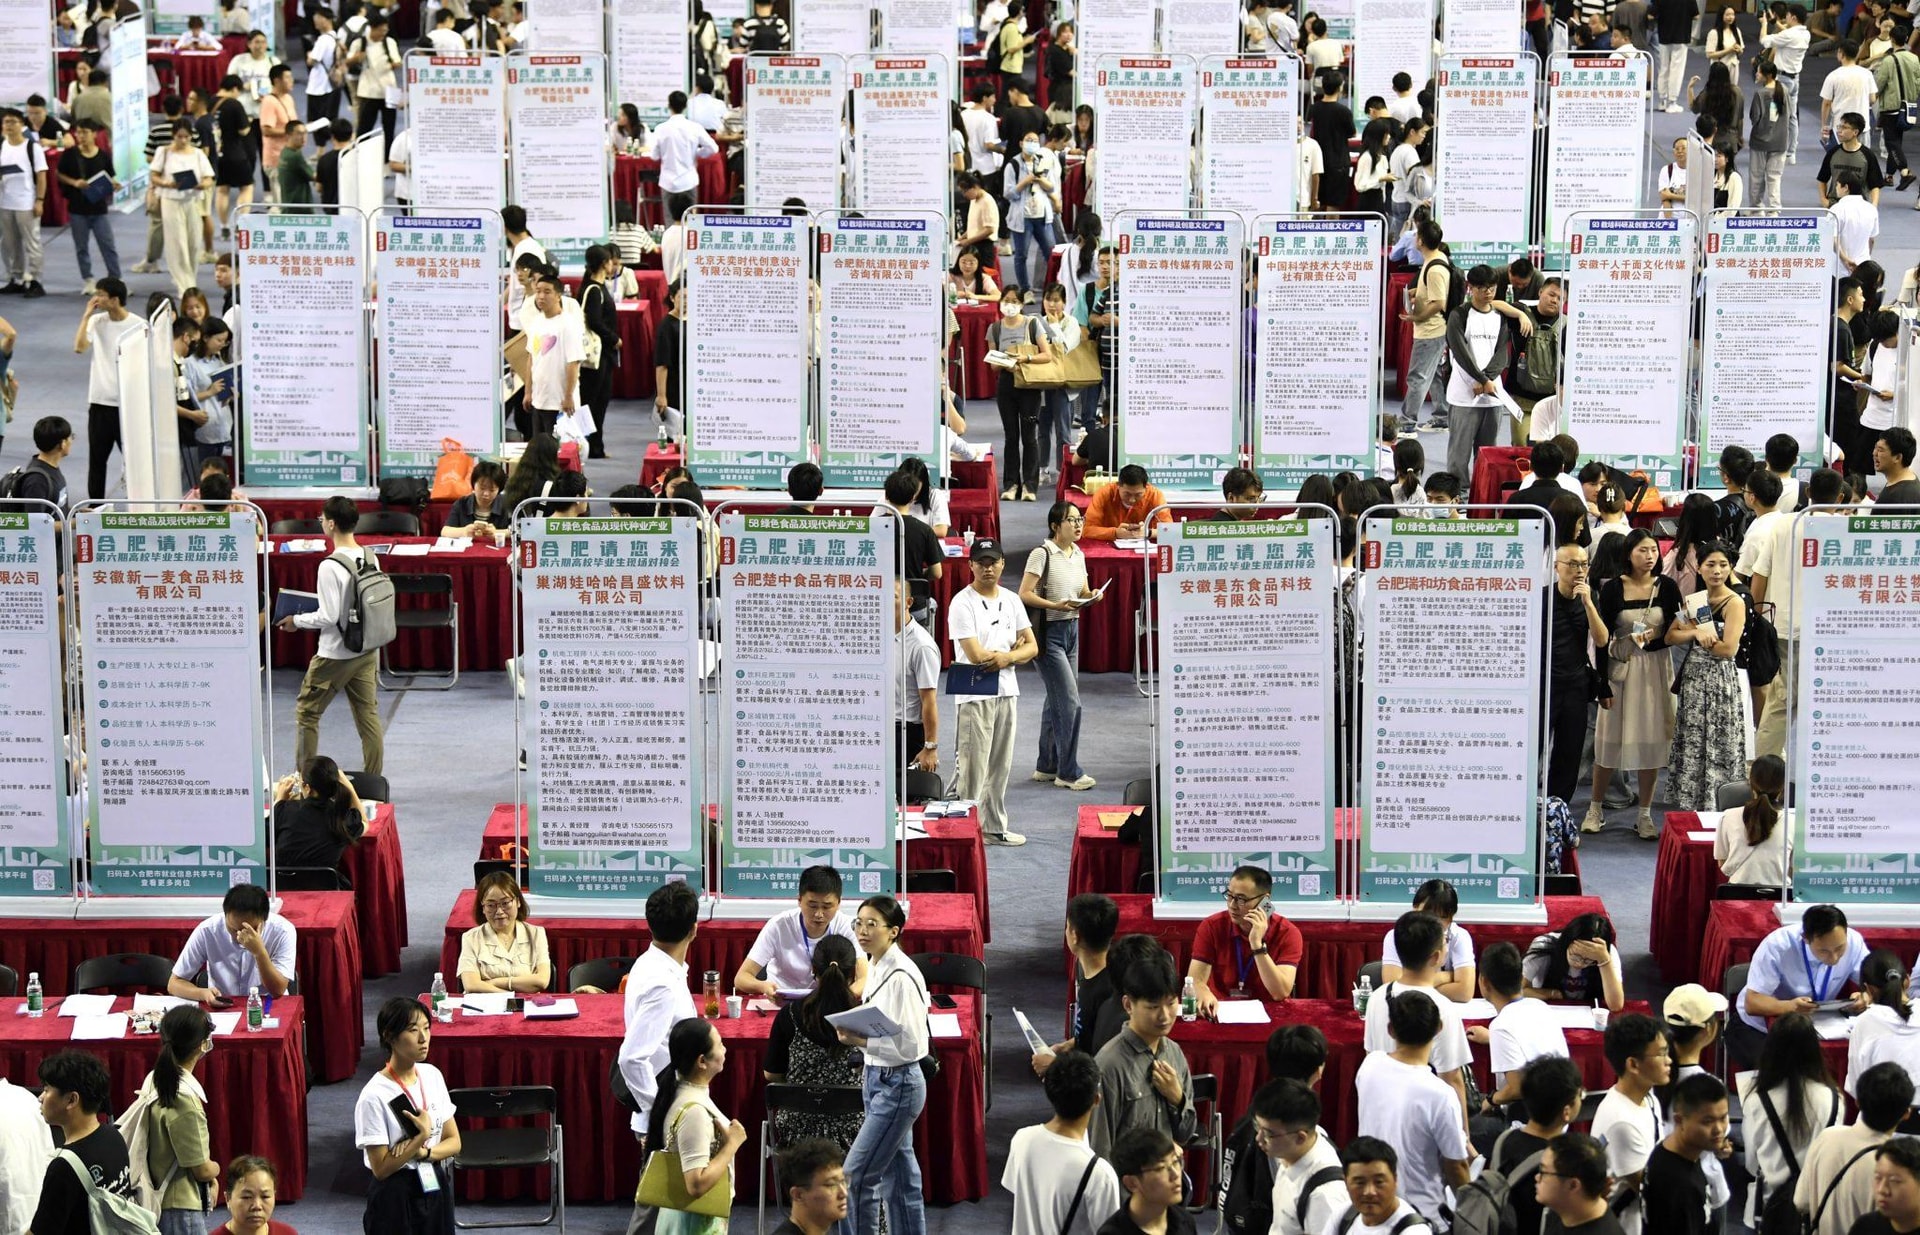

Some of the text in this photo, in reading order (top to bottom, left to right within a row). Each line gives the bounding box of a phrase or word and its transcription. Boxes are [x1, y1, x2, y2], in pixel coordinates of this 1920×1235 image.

[253, 231, 349, 243] 合肥请您来
[390, 232, 485, 245] 合肥请您来
[701, 231, 796, 242] 合肥请您来
[835, 234, 929, 246] 合肥请您来
[1133, 235, 1228, 247] 合肥请您来
[1586, 235, 1680, 246] 合肥请您来
[1723, 233, 1820, 245] 合肥请您来
[1273, 237, 1368, 248] 合肥请您来
[1267, 260, 1373, 271] 中国科学技术大学出版
[1579, 259, 1686, 269] 安徽千人千面文化传媒
[281, 266, 323, 277] 有限公司
[418, 268, 459, 278] 有限公司
[700, 266, 796, 277] 有限公司安徽分公司
[850, 269, 914, 280] 咨询有限公司
[1283, 271, 1357, 282] 社有限责任公司
[1610, 270, 1652, 280] 有限公司
[1748, 269, 1791, 279] 有限公司
[106, 517, 117, 525] 56
[550, 521, 668, 531] 57 绿色食品及现代种业产业
[1854, 520, 1866, 528] 61
[1396, 523, 1406, 531] 60
[98, 535, 236, 552] 合肥请您来
[541, 541, 678, 557] 合肥请您来
[740, 538, 875, 556] 合肥请您来
[1178, 542, 1314, 561] 合肥请您来
[1386, 542, 1524, 558] 合肥请您来
[96, 552, 239, 562] 第六期高校毕业生现场对接会
[540, 558, 680, 567] 第六期高校毕业生现场对接会
[738, 556, 877, 566] 第六期高校毕业生现场对接会
[1176, 560, 1316, 572] 第六期高校毕业生现场对接会
[1384, 559, 1525, 569] 第六期高校毕业生现场对接会
[93, 570, 244, 584] 安徽新一麦食品科技
[537, 575, 685, 589] 巢湖娃哈哈昌盛饮料
[733, 572, 882, 588] 合肥楚中食品有限公司
[1180, 577, 1312, 593] 安徽昊东食品科技
[1377, 576, 1531, 591] 合肥瑞和坊食品有限公司
[136, 585, 202, 599] 有限公司
[579, 591, 643, 604] 有限公司
[1214, 593, 1278, 607] 有限公司
